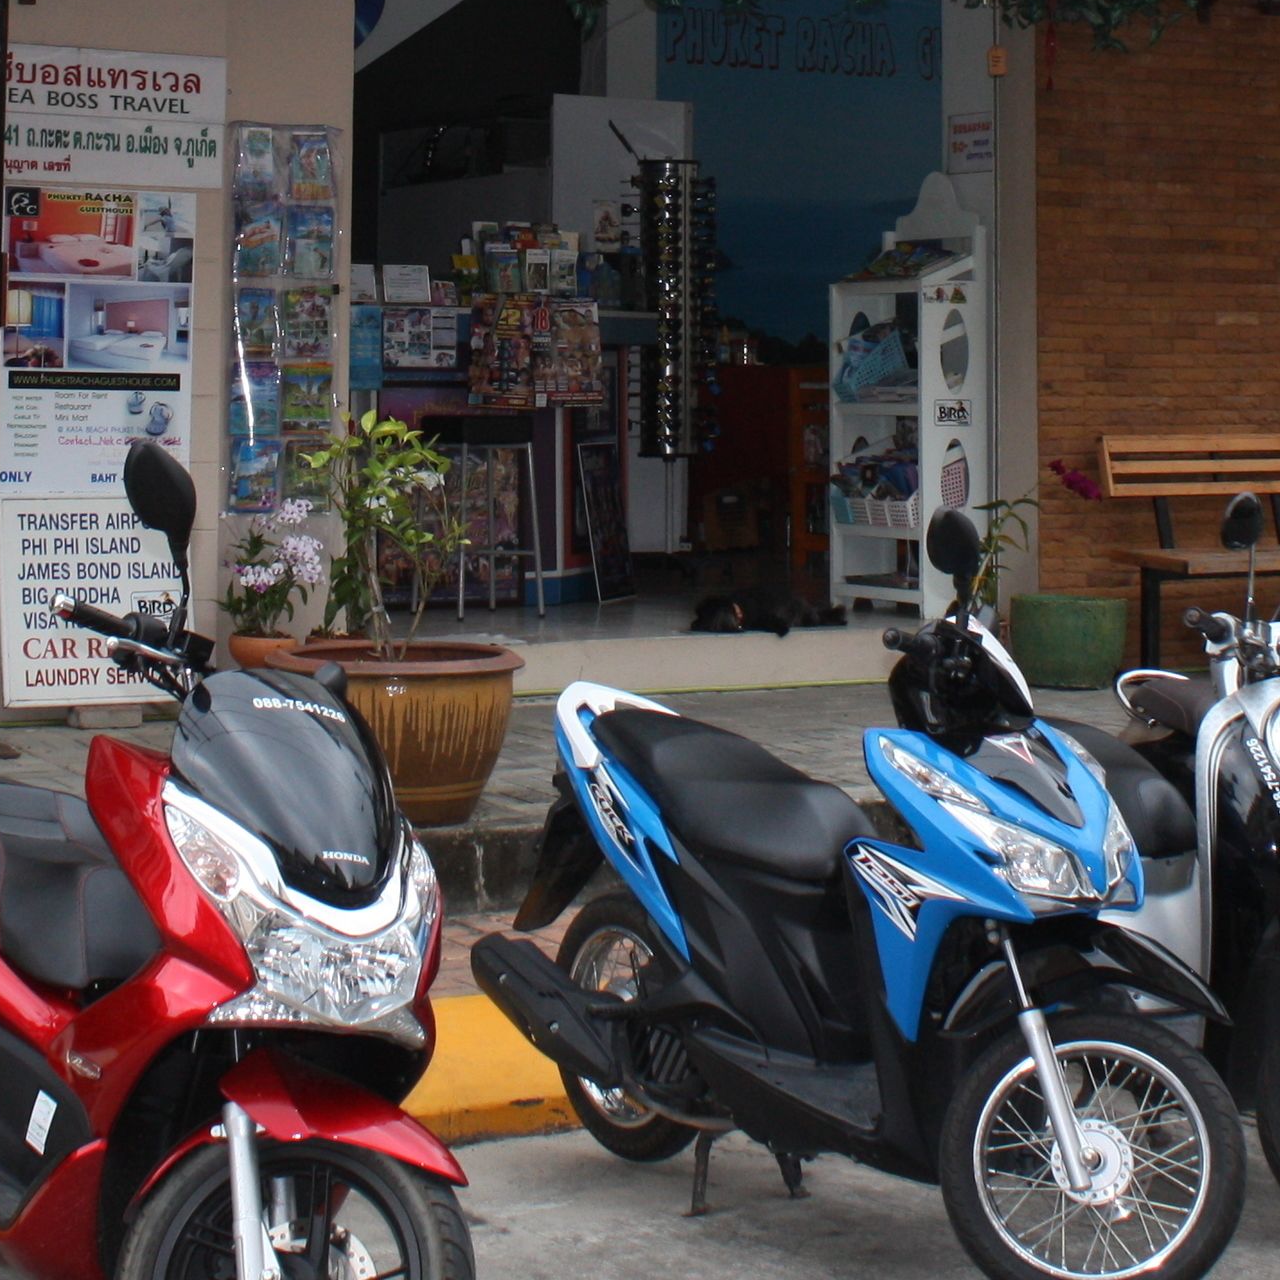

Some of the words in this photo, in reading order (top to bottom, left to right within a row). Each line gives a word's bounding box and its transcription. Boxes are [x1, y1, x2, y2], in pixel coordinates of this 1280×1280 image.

[47, 91, 98, 109] BOSS
[110, 94, 190, 115] TRAVEL
[85, 193, 133, 202] RACHA
[55, 402, 92, 411] Restaurant
[0, 470, 32, 483] ONLY
[90, 473, 117, 483] BAHT
[18, 513, 99, 531] TRANSFER
[22, 538, 47, 556] PHI
[54, 537, 79, 555] PHI
[86, 537, 141, 554] ISLAND
[18, 562, 70, 580] JAMES
[77, 562, 120, 580] BOND
[128, 562, 182, 579] ISLAND
[22, 587, 48, 604] BIG
[23, 612, 58, 629] VISA
[23, 637, 79, 660] CAR
[25, 668, 100, 687] LAUNDRY
[322, 850, 370, 866] HONDA
